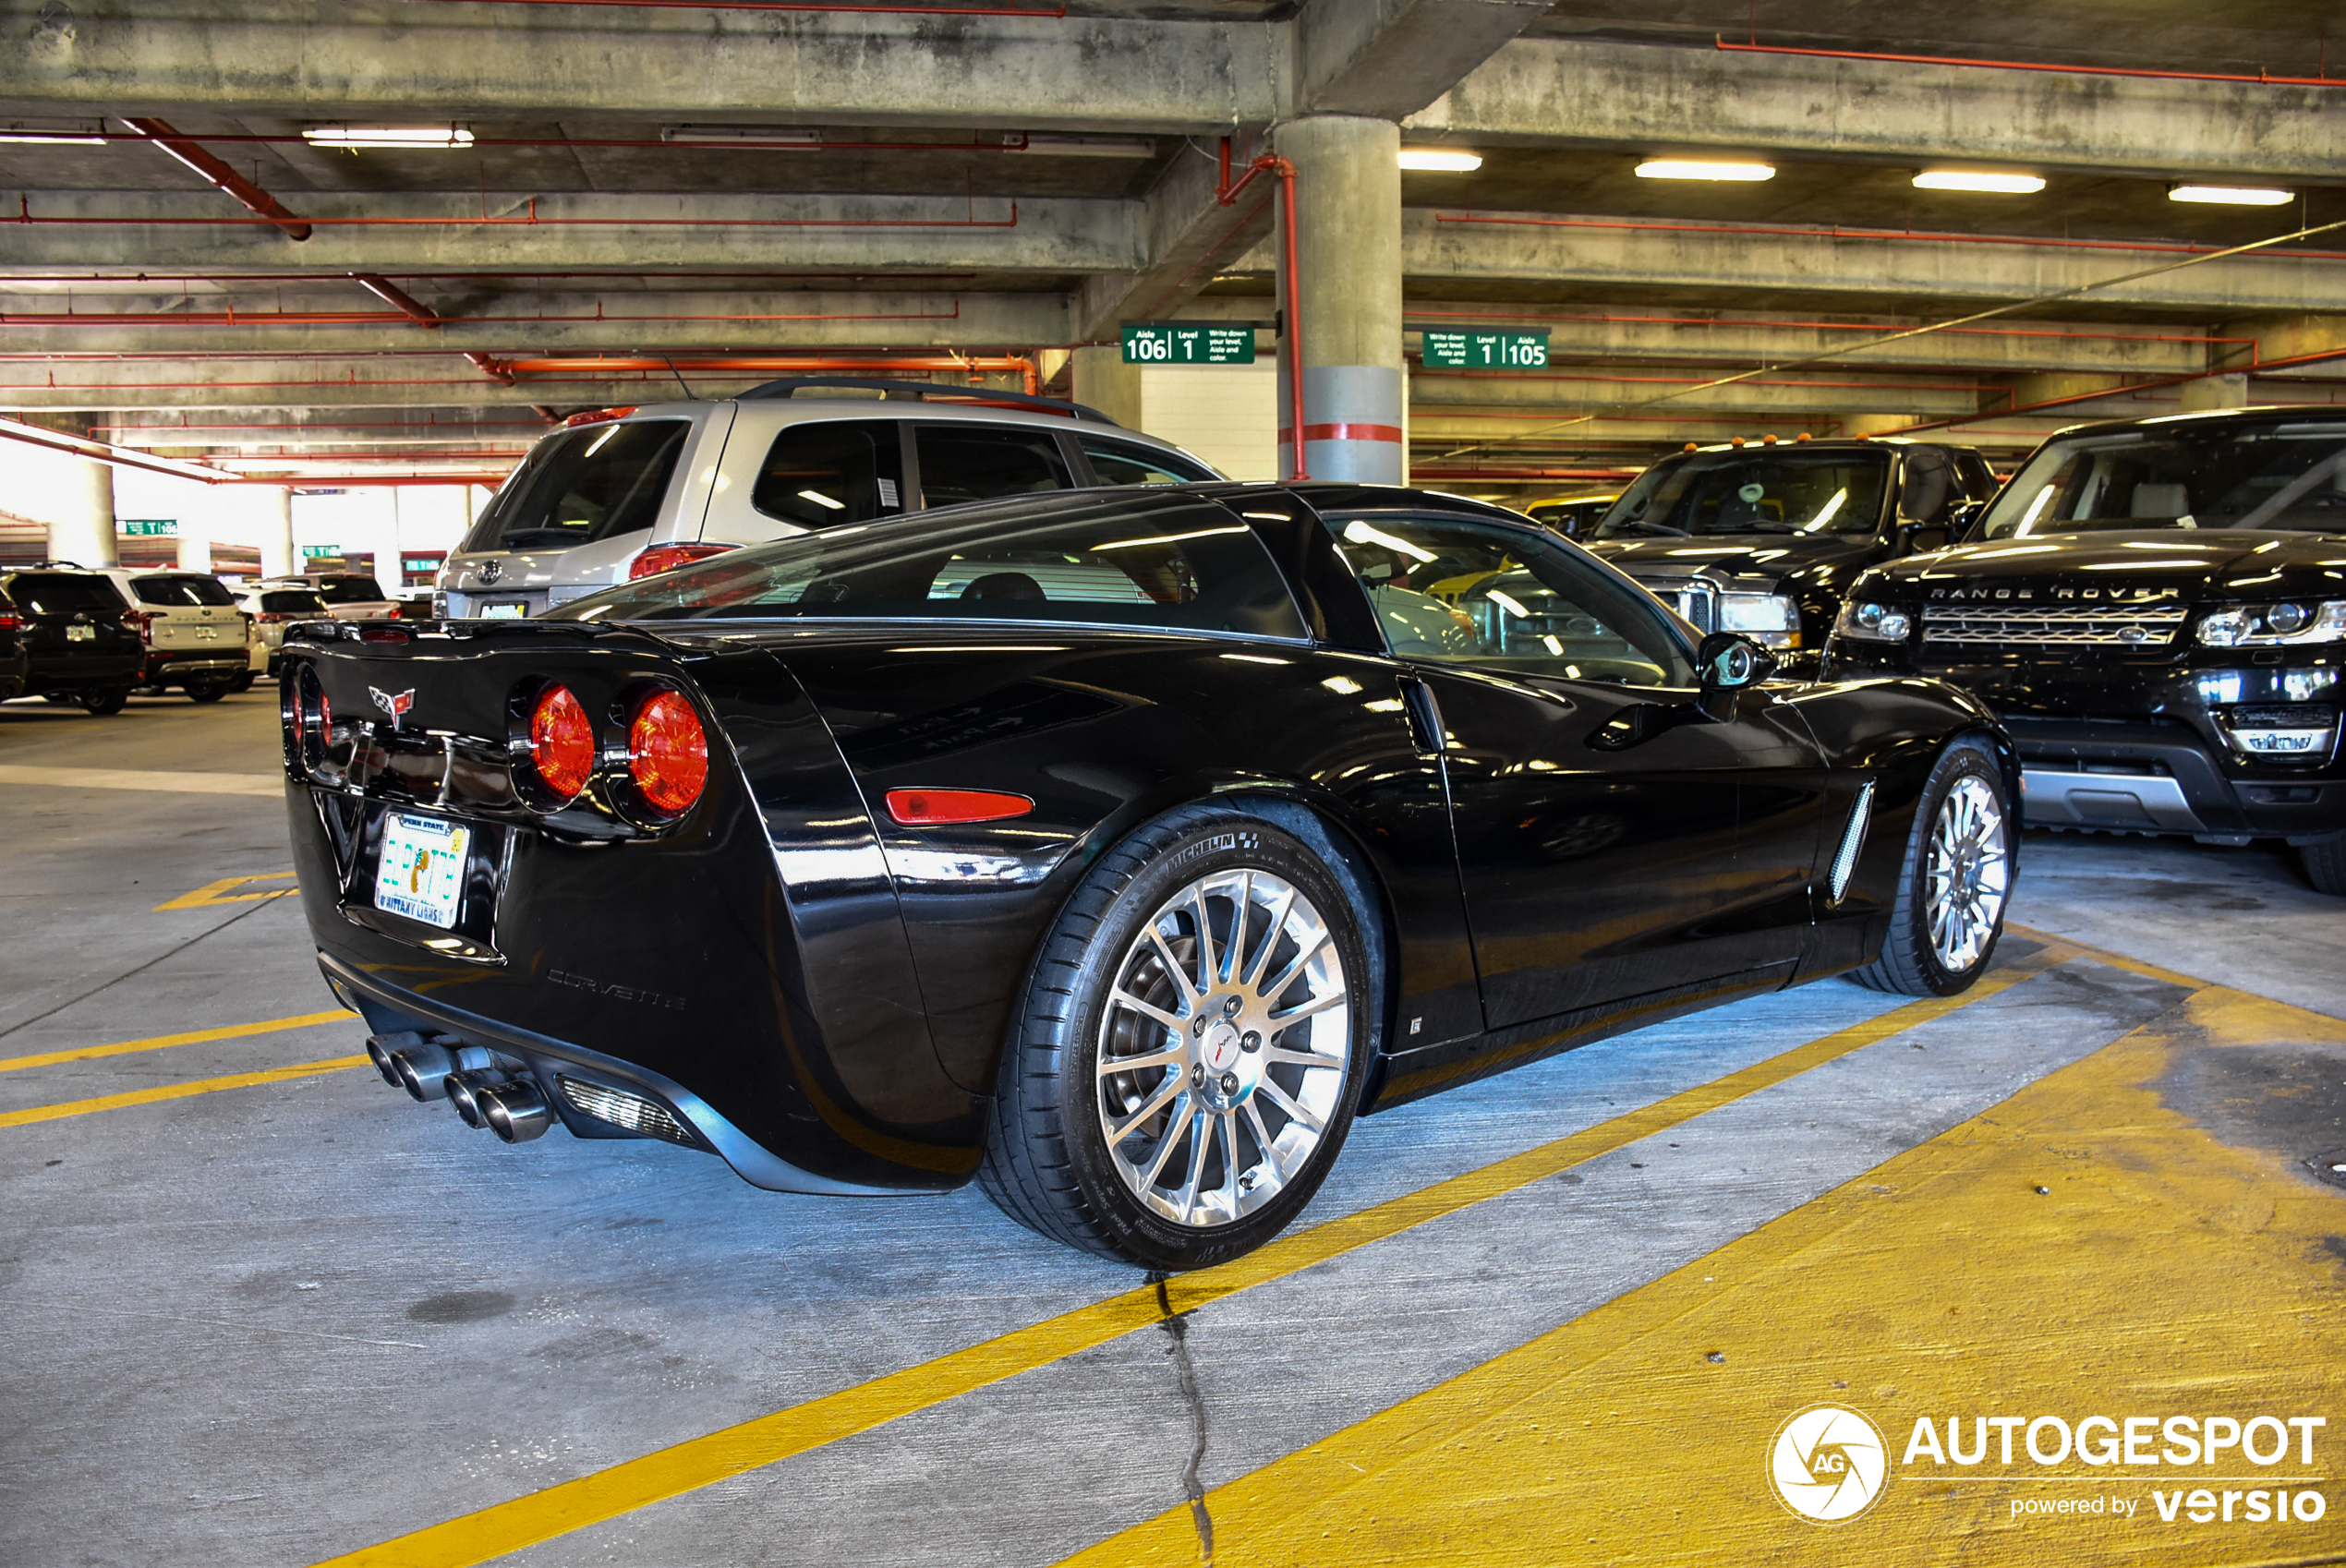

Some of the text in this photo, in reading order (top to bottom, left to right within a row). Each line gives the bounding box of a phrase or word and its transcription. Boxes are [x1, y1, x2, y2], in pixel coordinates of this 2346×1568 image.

[1136, 330, 1155, 339] Aisle
[1178, 331, 1198, 339] Level
[1127, 339, 1167, 360] 106
[1183, 340, 1192, 360] 1
[1481, 344, 1490, 364] 1
[1509, 345, 1545, 366] 105
[1930, 588, 2180, 598] RANGE ROVER
[403, 817, 444, 831] PENN STATE
[1166, 833, 1236, 875] MICHELIN
[547, 969, 686, 1010] CORVETTE
[1110, 1212, 1131, 1235] Pilot
